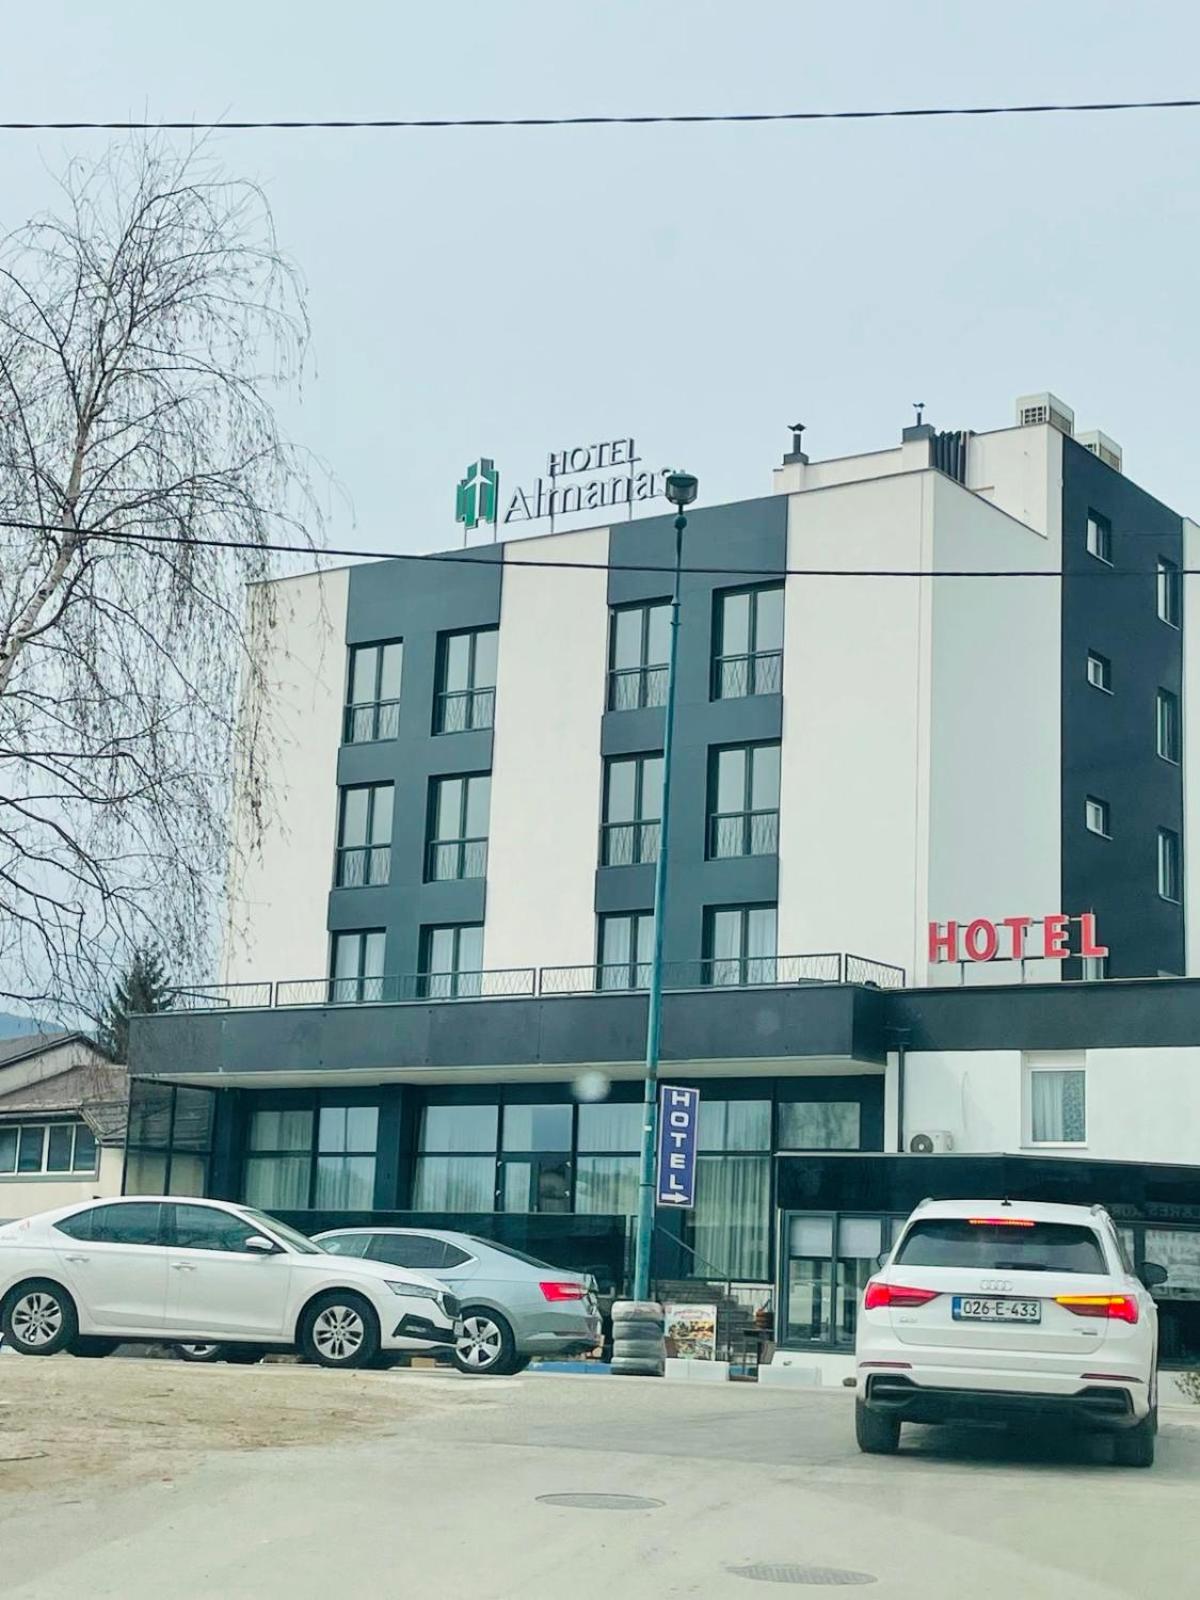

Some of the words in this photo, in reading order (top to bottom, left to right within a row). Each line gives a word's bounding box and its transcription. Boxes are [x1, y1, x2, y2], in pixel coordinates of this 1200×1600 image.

[548, 437, 641, 476] HOTEL
[928, 911, 1109, 964] HOTEL
[669, 1090, 690, 1190] HOTEL
[963, 1300, 1037, 1317] 026-E-433
